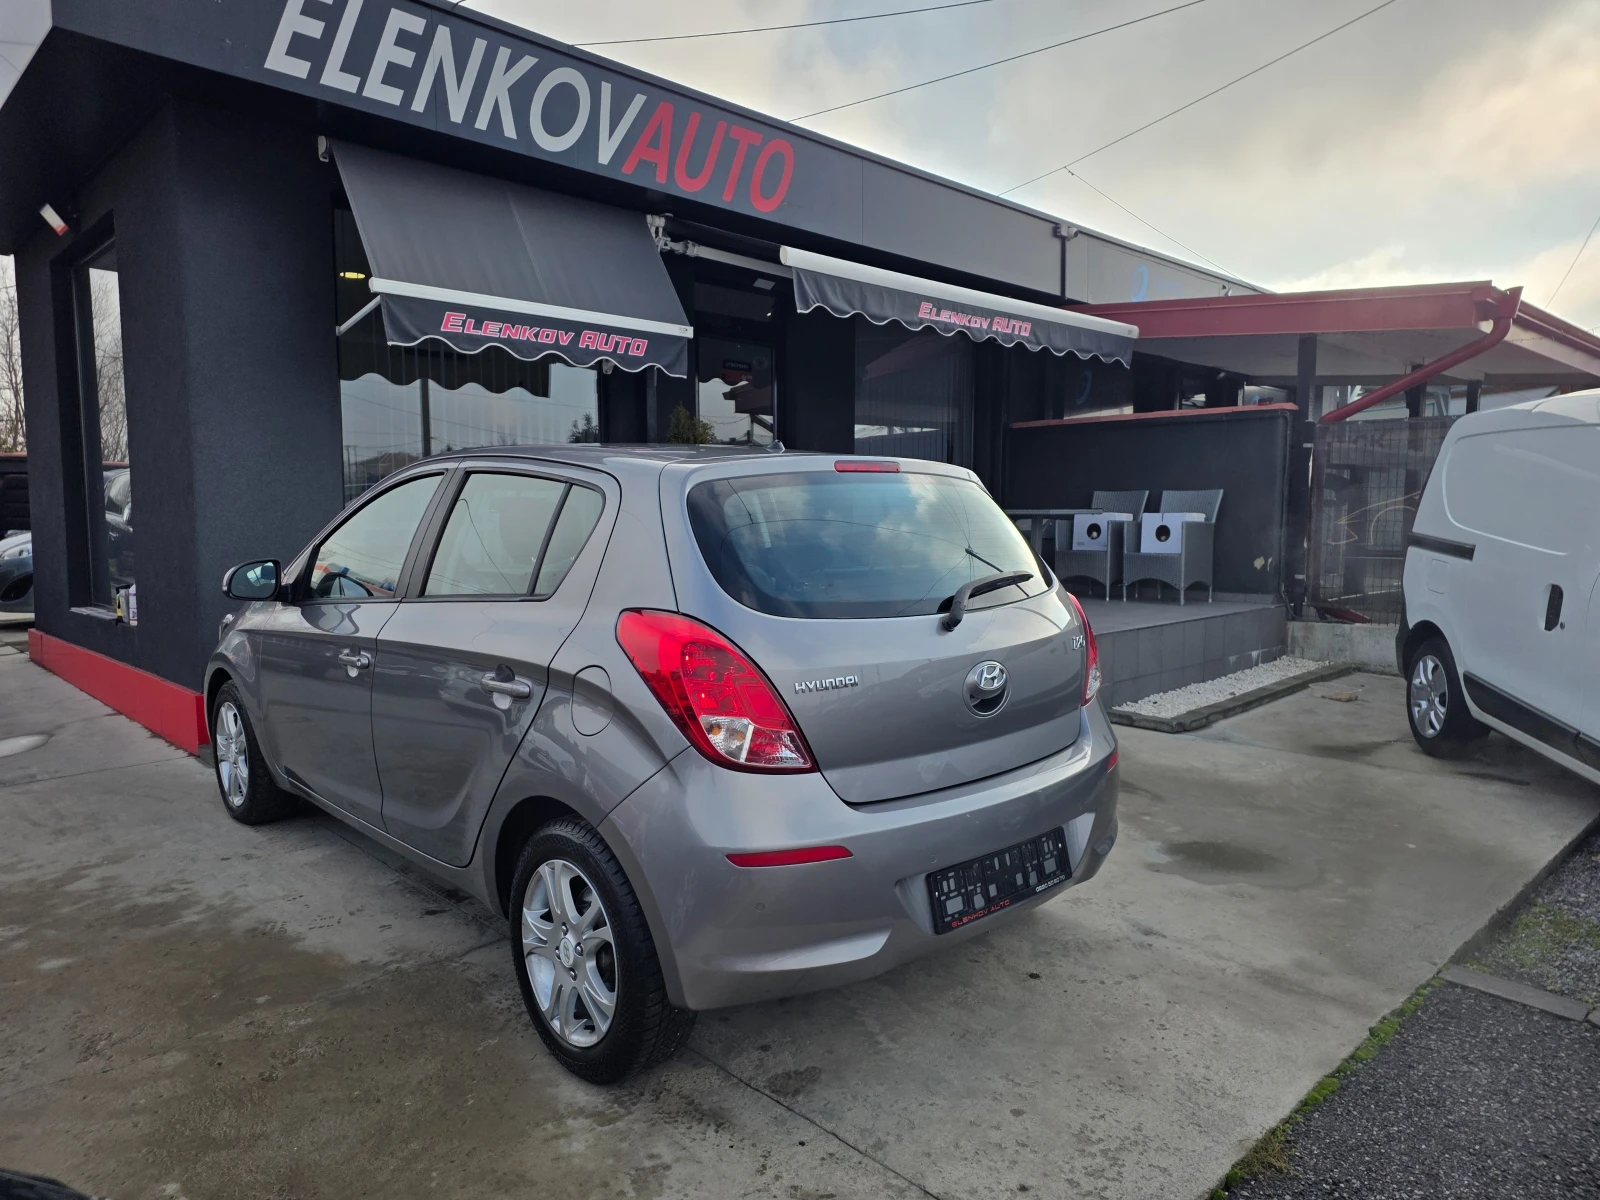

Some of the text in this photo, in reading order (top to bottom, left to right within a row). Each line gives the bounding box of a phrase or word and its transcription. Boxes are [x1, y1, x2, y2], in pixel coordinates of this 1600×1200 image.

[918, 301, 1032, 337] ELENKOV AUTO
[440, 311, 648, 357] ELENKOV AUTO
[794, 675, 859, 694] HYUNDAI
[990, 899, 1010, 912] AUTO
